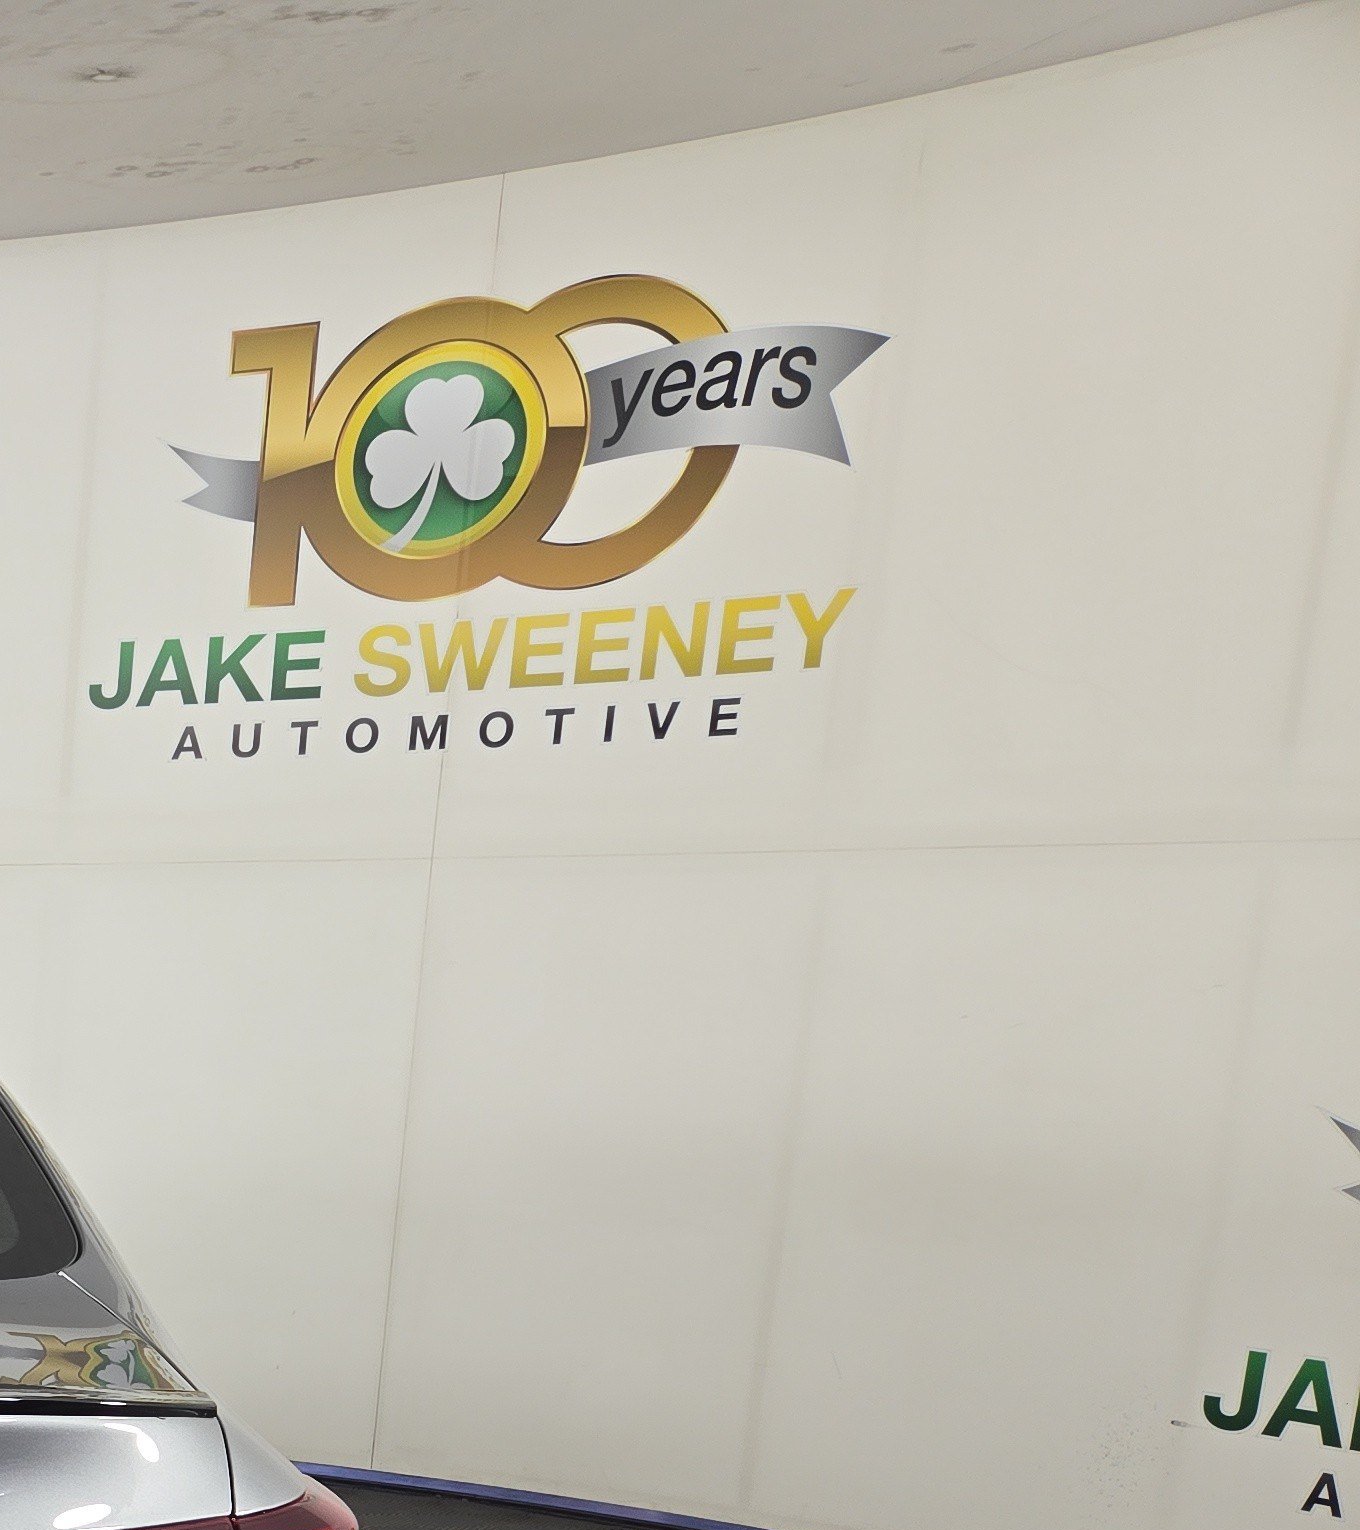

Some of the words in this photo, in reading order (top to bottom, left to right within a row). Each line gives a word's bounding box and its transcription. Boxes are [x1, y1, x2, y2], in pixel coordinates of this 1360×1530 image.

[230, 273, 738, 606] 100
[602, 346, 816, 448] years
[88, 630, 326, 709] JAKE
[353, 587, 858, 697] SWEENEY
[172, 698, 742, 760] AUTOMOTIVE
[1203, 1350, 1360, 1452] JA
